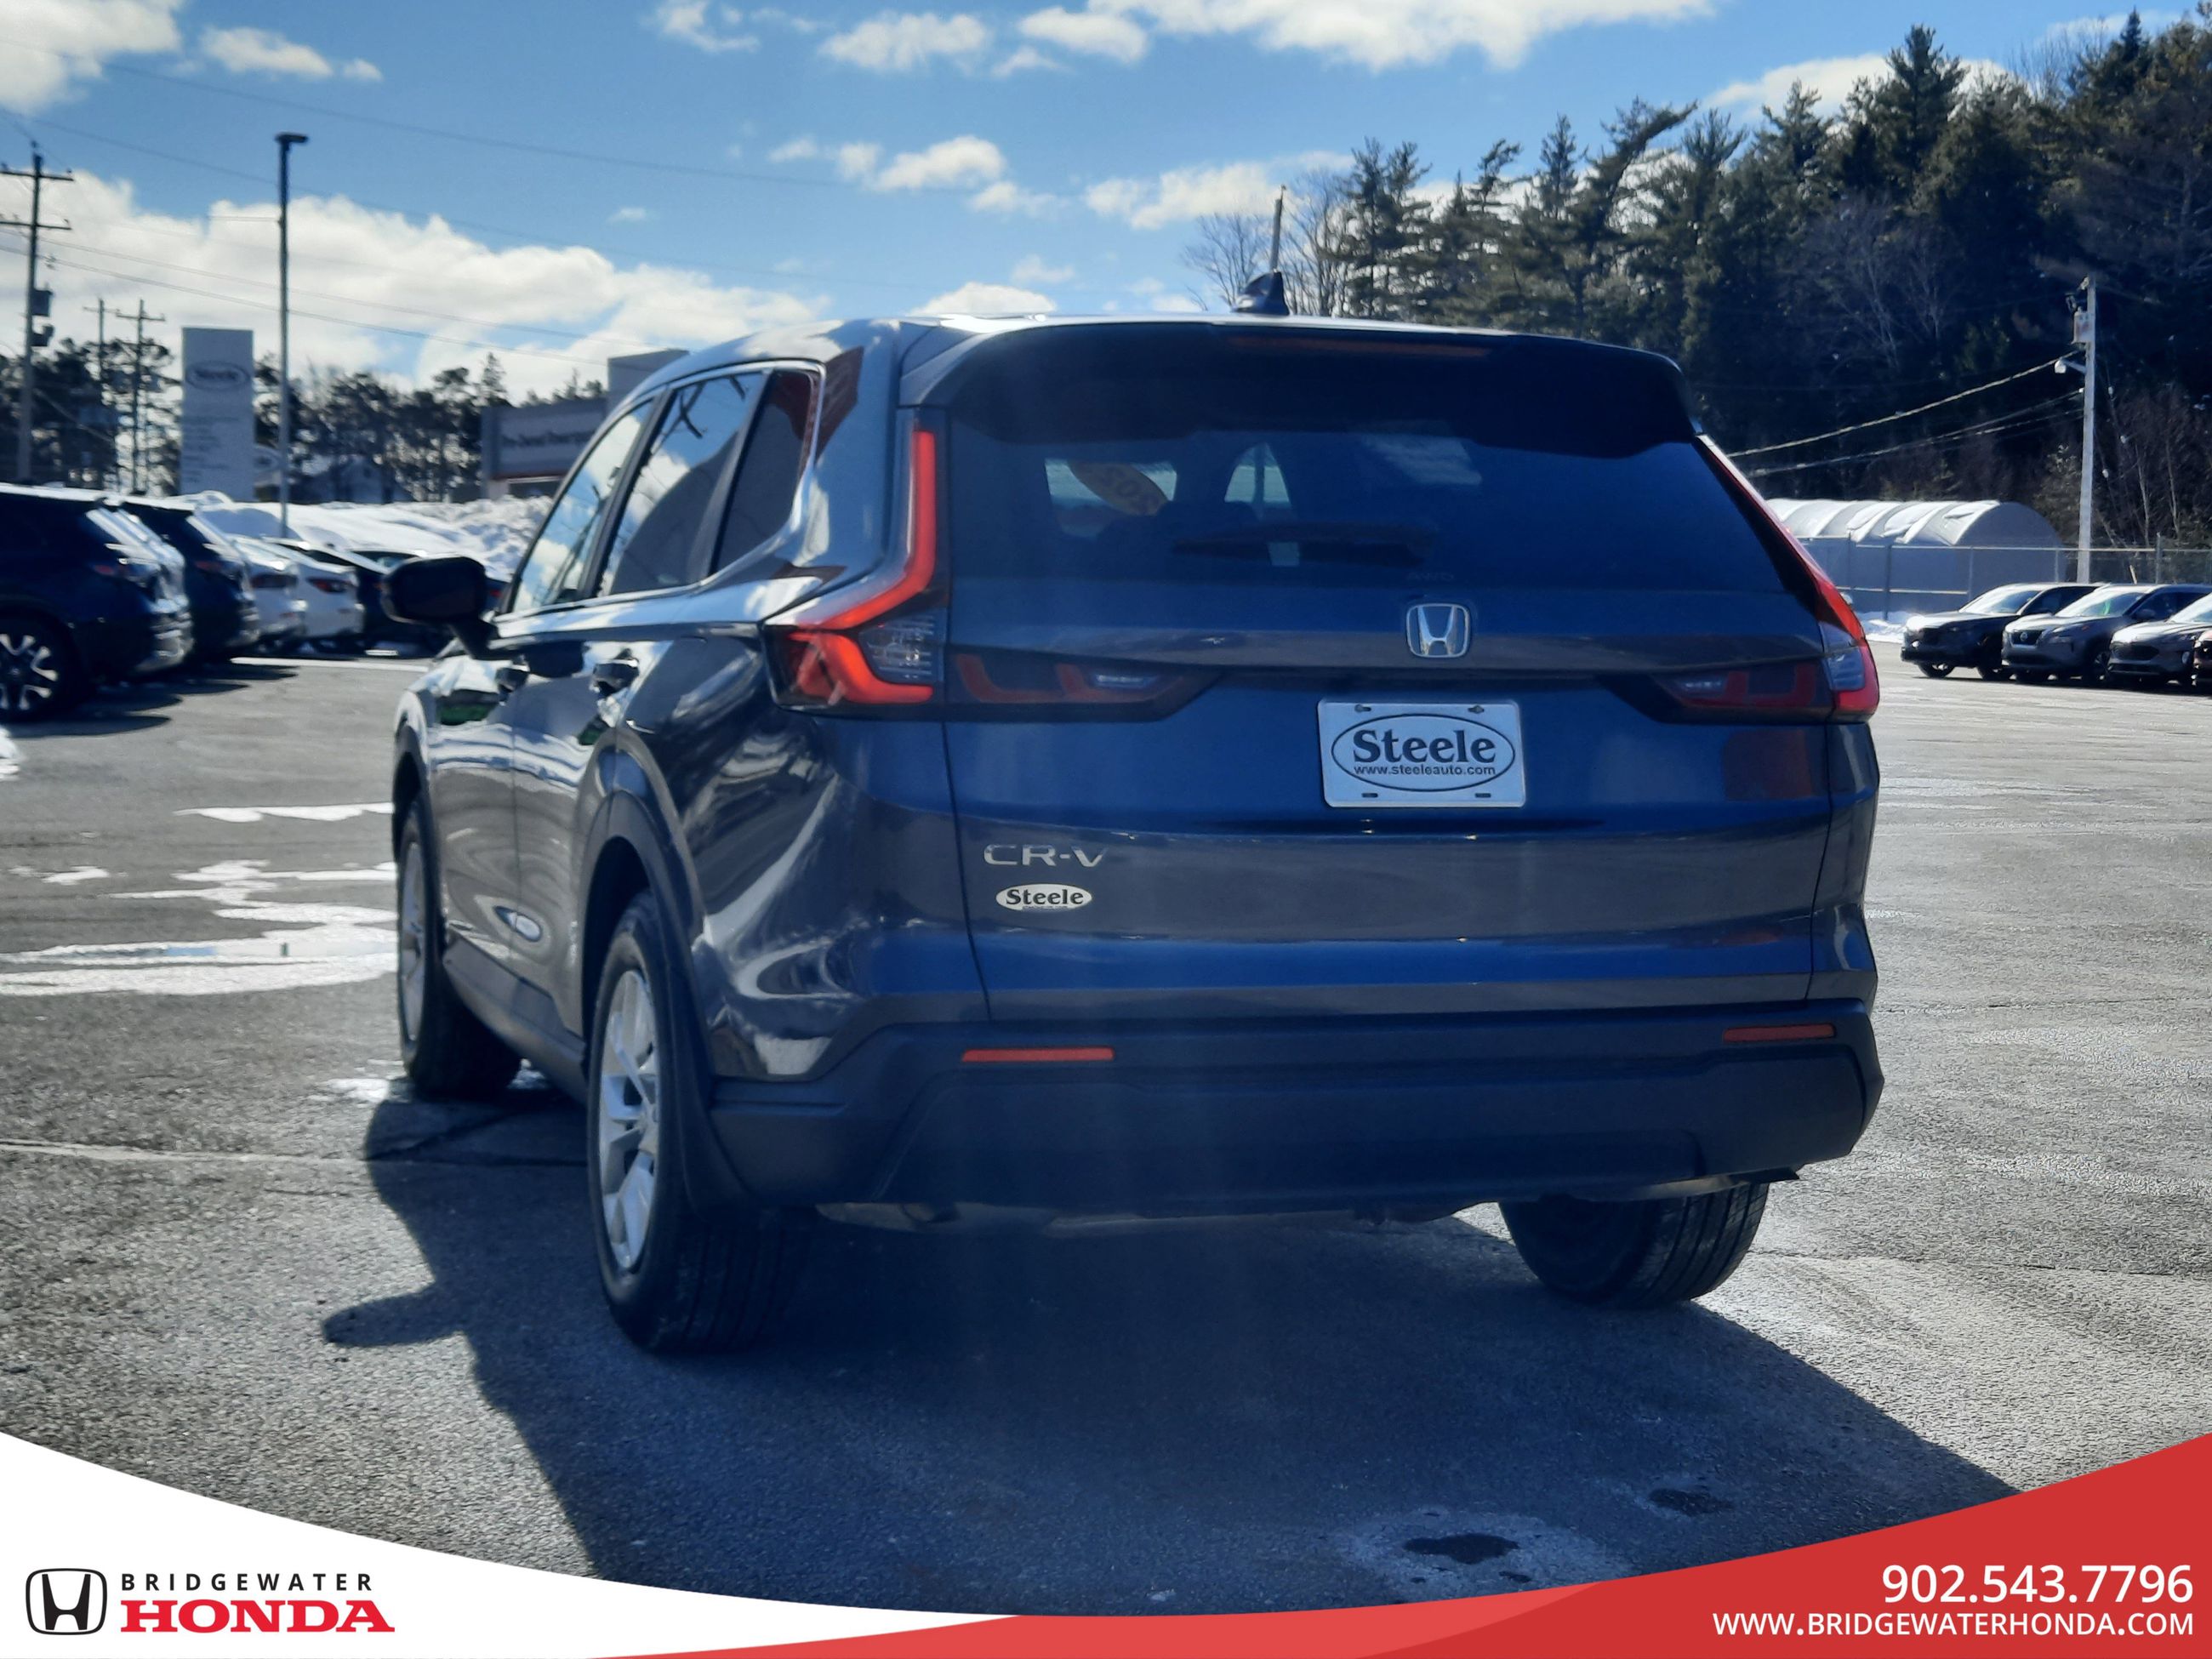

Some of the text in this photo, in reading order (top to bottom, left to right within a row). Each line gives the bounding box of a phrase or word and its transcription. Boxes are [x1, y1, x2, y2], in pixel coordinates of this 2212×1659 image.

[1353, 729, 1497, 763] Steele
[1354, 765, 1497, 775] www.steeleauto.com
[983, 844, 1109, 868] CR-V
[1006, 889, 1084, 905] Steele
